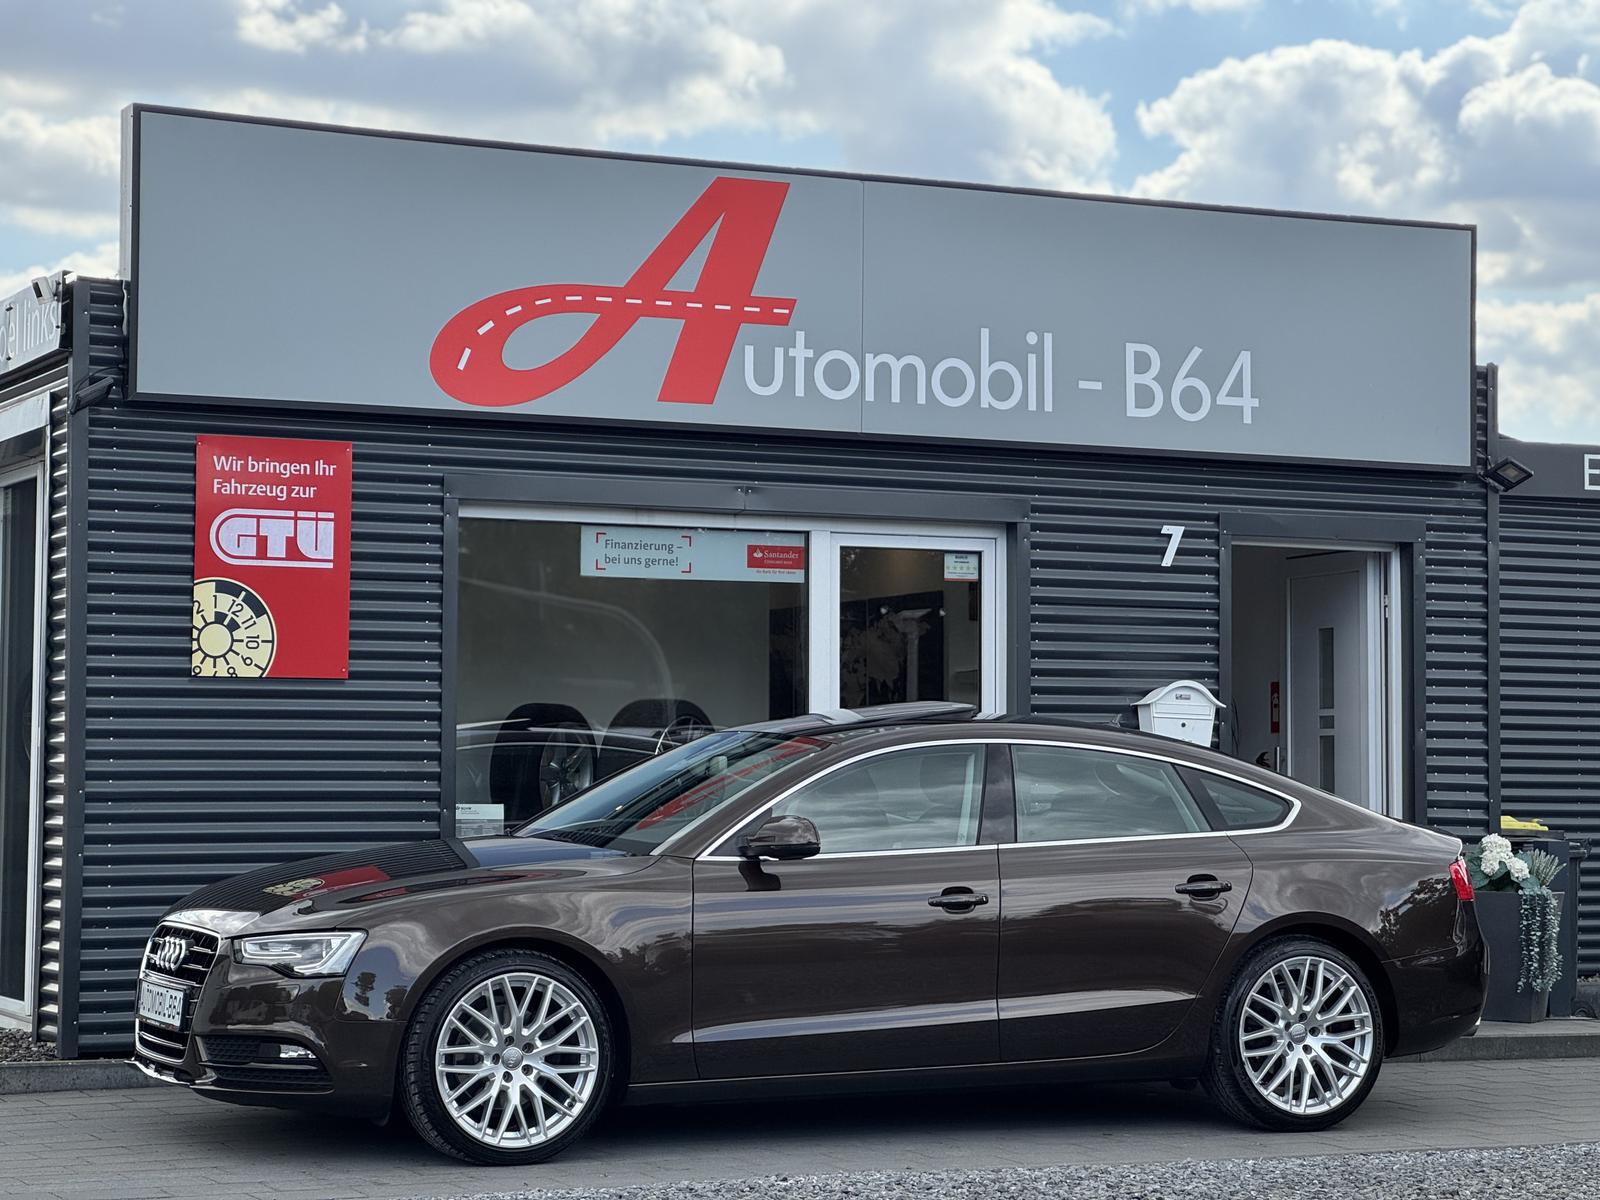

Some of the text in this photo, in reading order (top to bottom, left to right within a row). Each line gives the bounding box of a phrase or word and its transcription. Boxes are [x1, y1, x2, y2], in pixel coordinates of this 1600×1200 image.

[23, 299, 58, 352] links
[1125, 342, 1260, 424] B64
[213, 456, 337, 478] Wir bringen Ihr
[213, 478, 317, 501] Fahrzeug zur
[211, 508, 334, 566] GTÜ
[1160, 525, 1185, 567] 7
[604, 539, 674, 554] Finanzierung
[763, 550, 799, 559] Santander
[604, 553, 679, 568] bei uns gerne!
[193, 600, 204, 615] 2
[228, 599, 244, 617] 12
[241, 615, 257, 630] 11
[246, 634, 260, 650] 10
